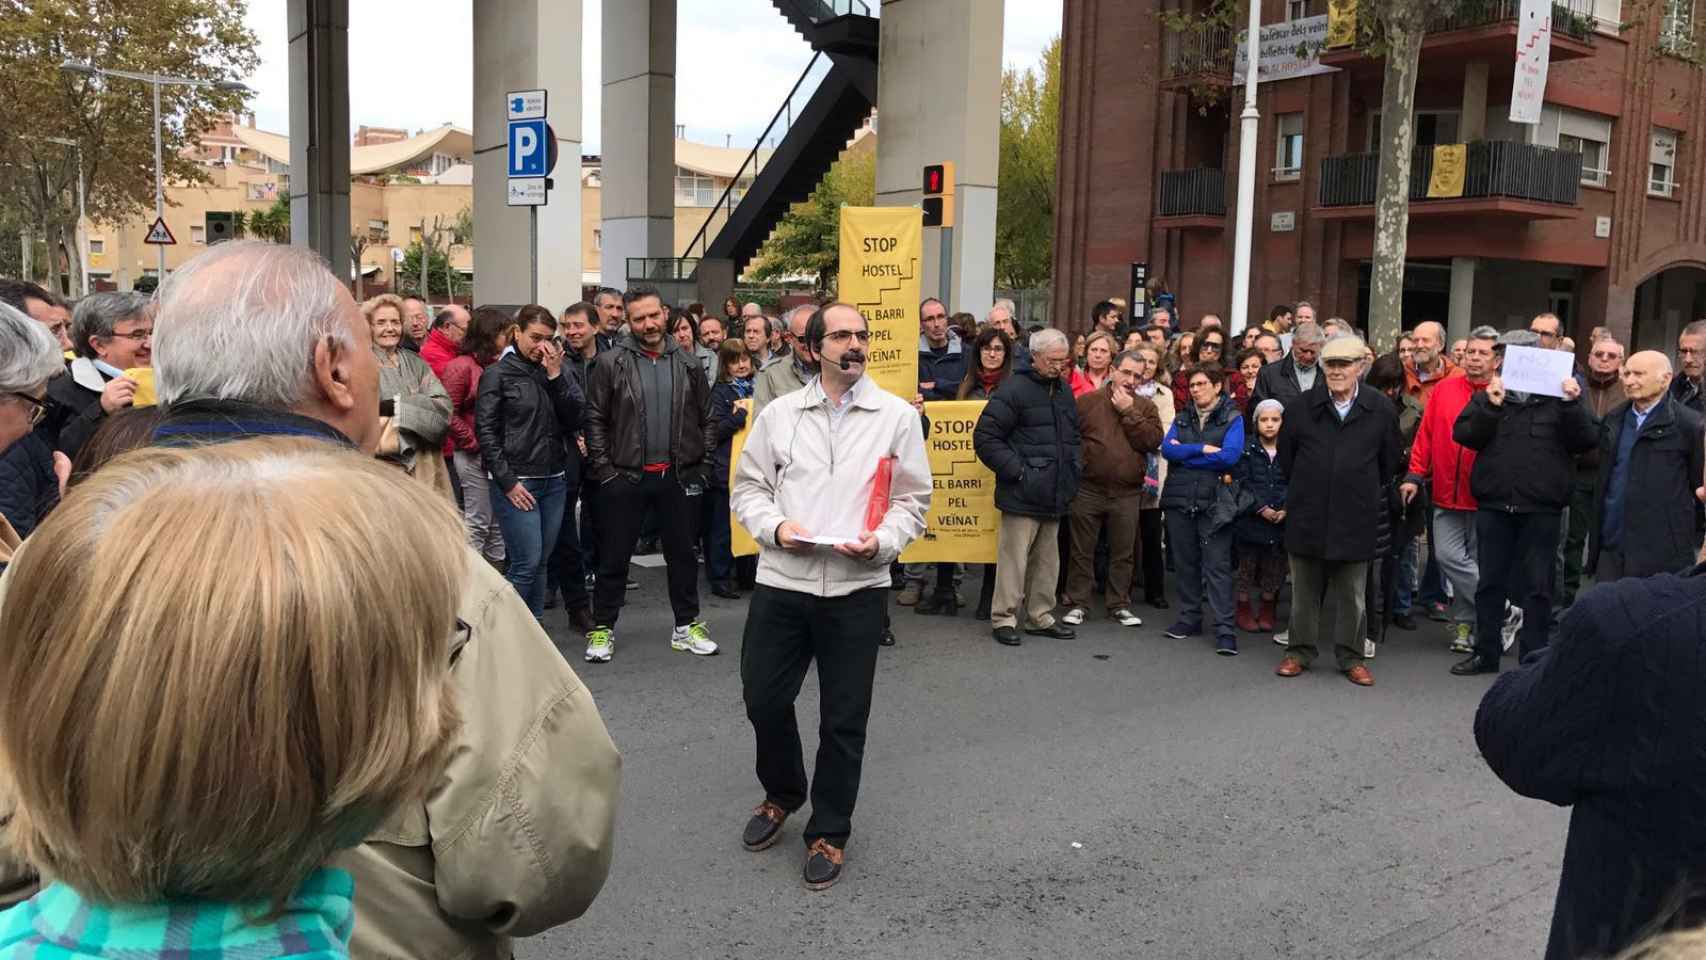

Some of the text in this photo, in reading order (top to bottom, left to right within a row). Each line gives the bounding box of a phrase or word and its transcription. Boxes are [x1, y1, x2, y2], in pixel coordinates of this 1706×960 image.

[515, 127, 537, 171] P
[863, 237, 898, 252] STOP
[862, 264, 903, 277] HOSTEL
[875, 308, 905, 321] BARRI
[875, 330, 893, 341] PEL
[934, 420, 975, 434] STOP
[933, 479, 982, 489] EL BARRI
[948, 497, 968, 508] PEL
[937, 513, 980, 526] VEÏNAT
